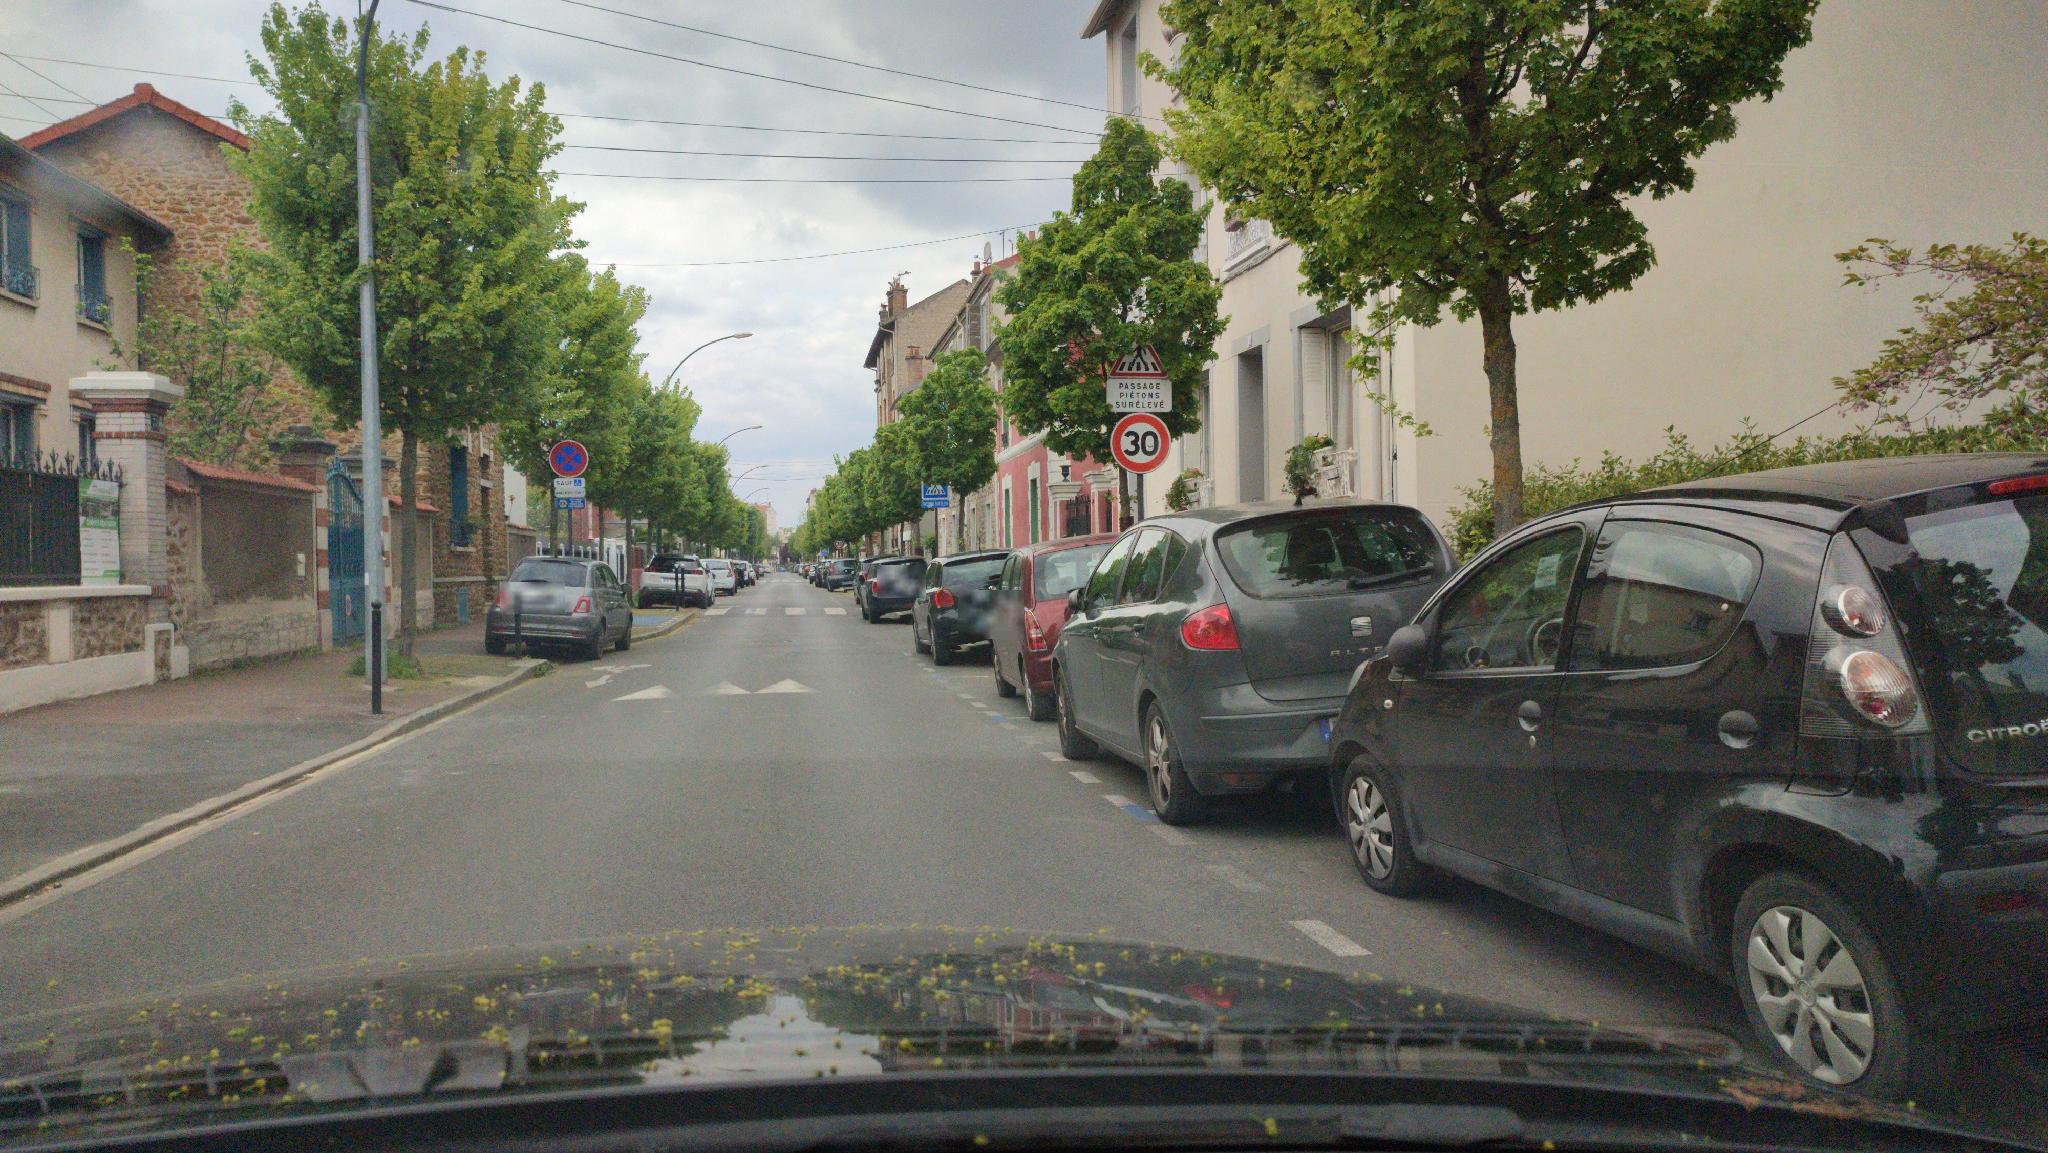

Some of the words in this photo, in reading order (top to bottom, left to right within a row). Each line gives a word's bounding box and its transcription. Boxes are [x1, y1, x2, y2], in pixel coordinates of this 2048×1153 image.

[1119, 382, 1161, 390] PASSAGE
[1120, 391, 1160, 399] PIÉTONS
[1115, 400, 1165, 409] SURÉLEVÉ
[1123, 430, 1159, 457] 30
[1330, 646, 1383, 656] ALTE
